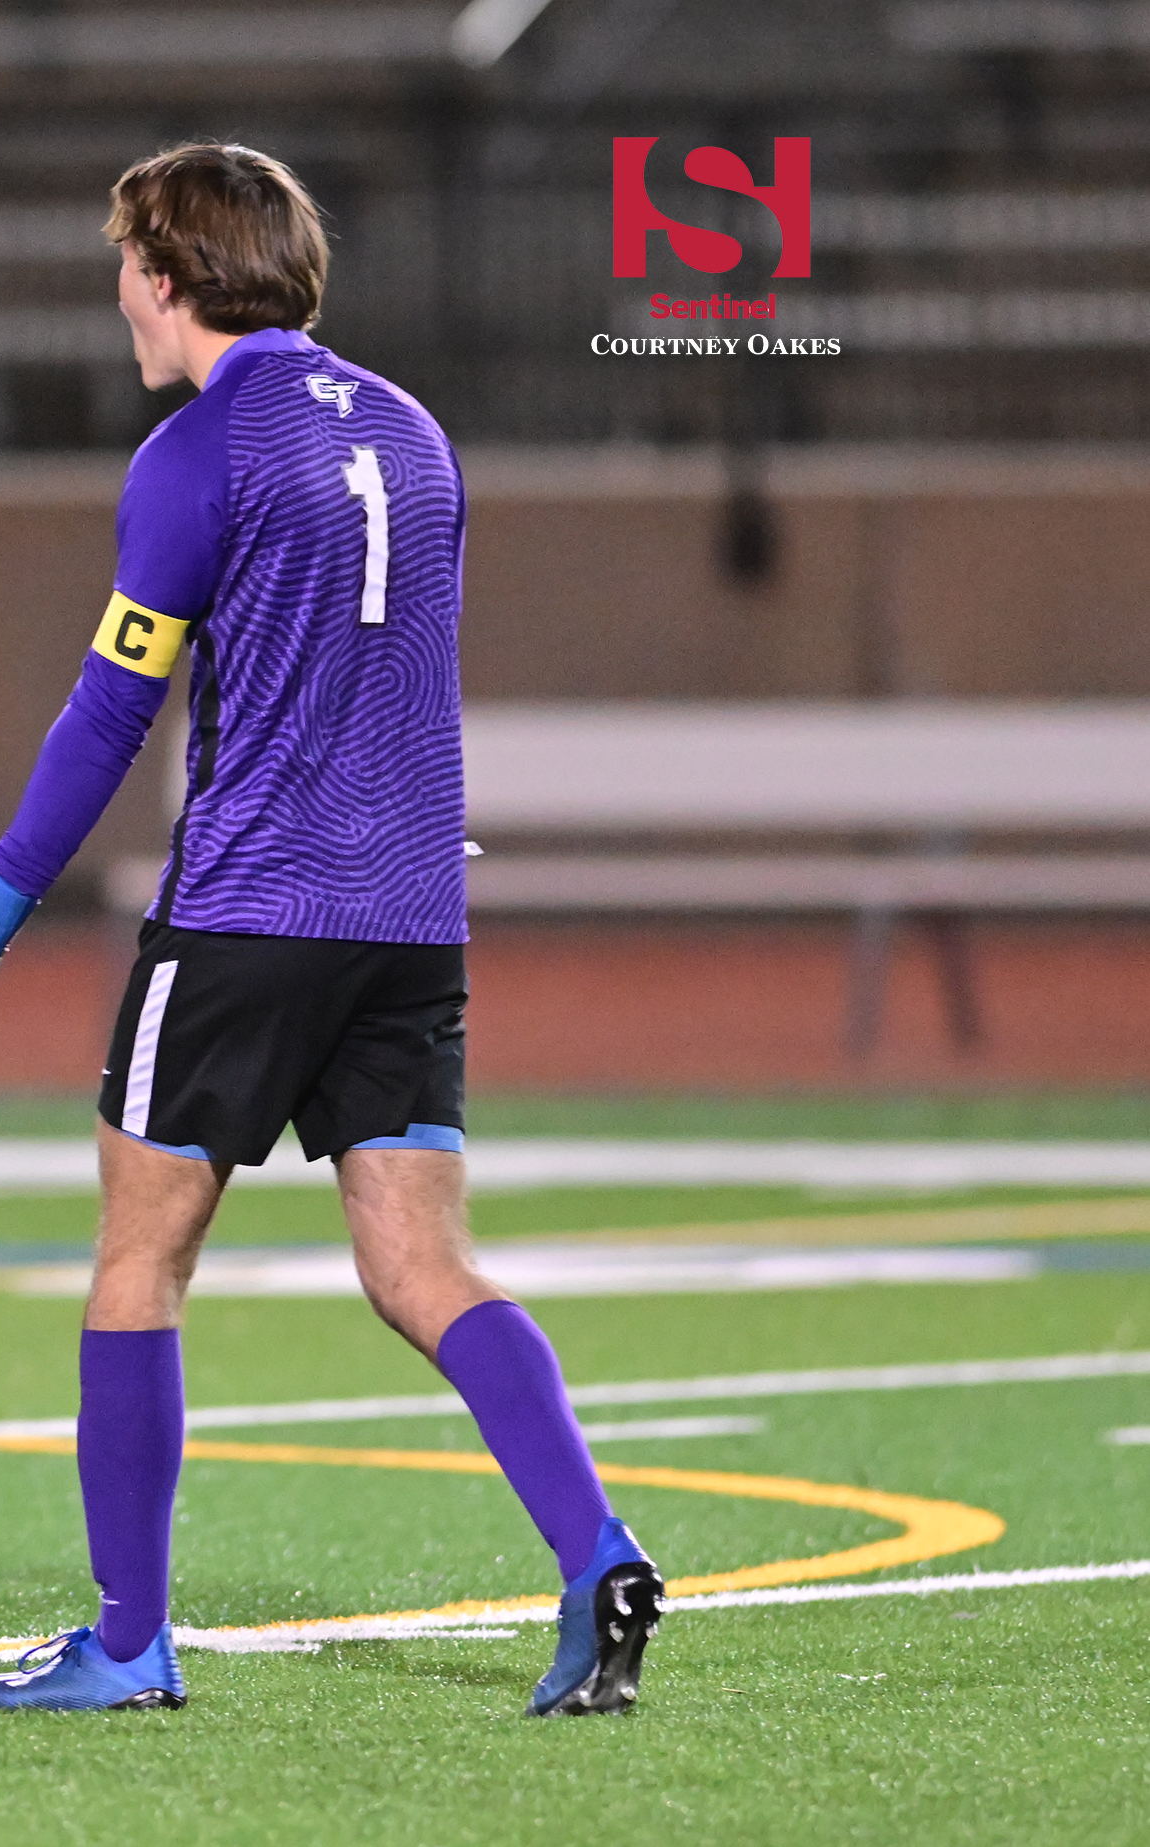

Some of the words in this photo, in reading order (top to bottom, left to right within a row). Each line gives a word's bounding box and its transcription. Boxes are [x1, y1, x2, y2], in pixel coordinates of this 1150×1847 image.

[304, 374, 361, 418] CT
[341, 445, 390, 624] 1
[114, 609, 155, 661] C
